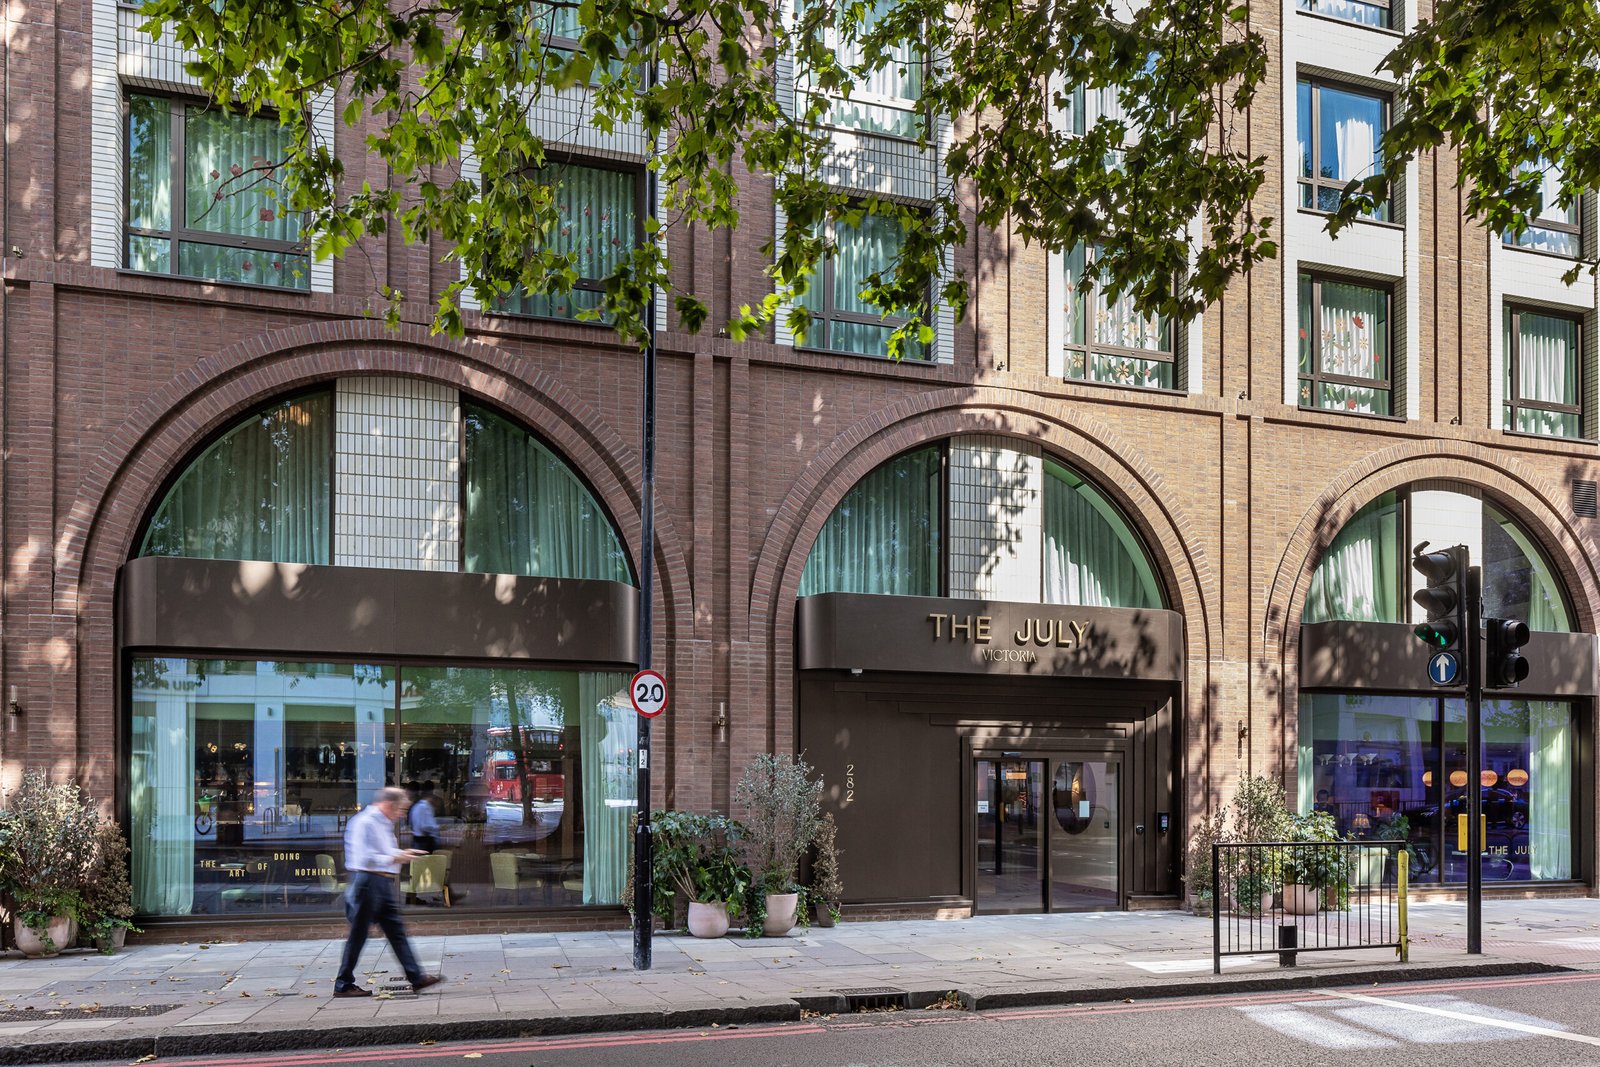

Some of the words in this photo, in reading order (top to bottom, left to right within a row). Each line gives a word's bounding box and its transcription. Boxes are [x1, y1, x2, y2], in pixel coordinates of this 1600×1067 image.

[929, 613, 993, 640] THE
[1016, 618, 1090, 643] JULY
[982, 649, 1037, 663] VICTORIA
[636, 683, 664, 703] 20
[846, 764, 855, 802] 282
[1489, 845, 1509, 855] THE
[1514, 845, 1538, 855] JULY
[200, 860, 216, 868] THE
[229, 869, 246, 877] ART
[274, 852, 300, 860] DOING
[295, 868, 332, 876] NOTHING
